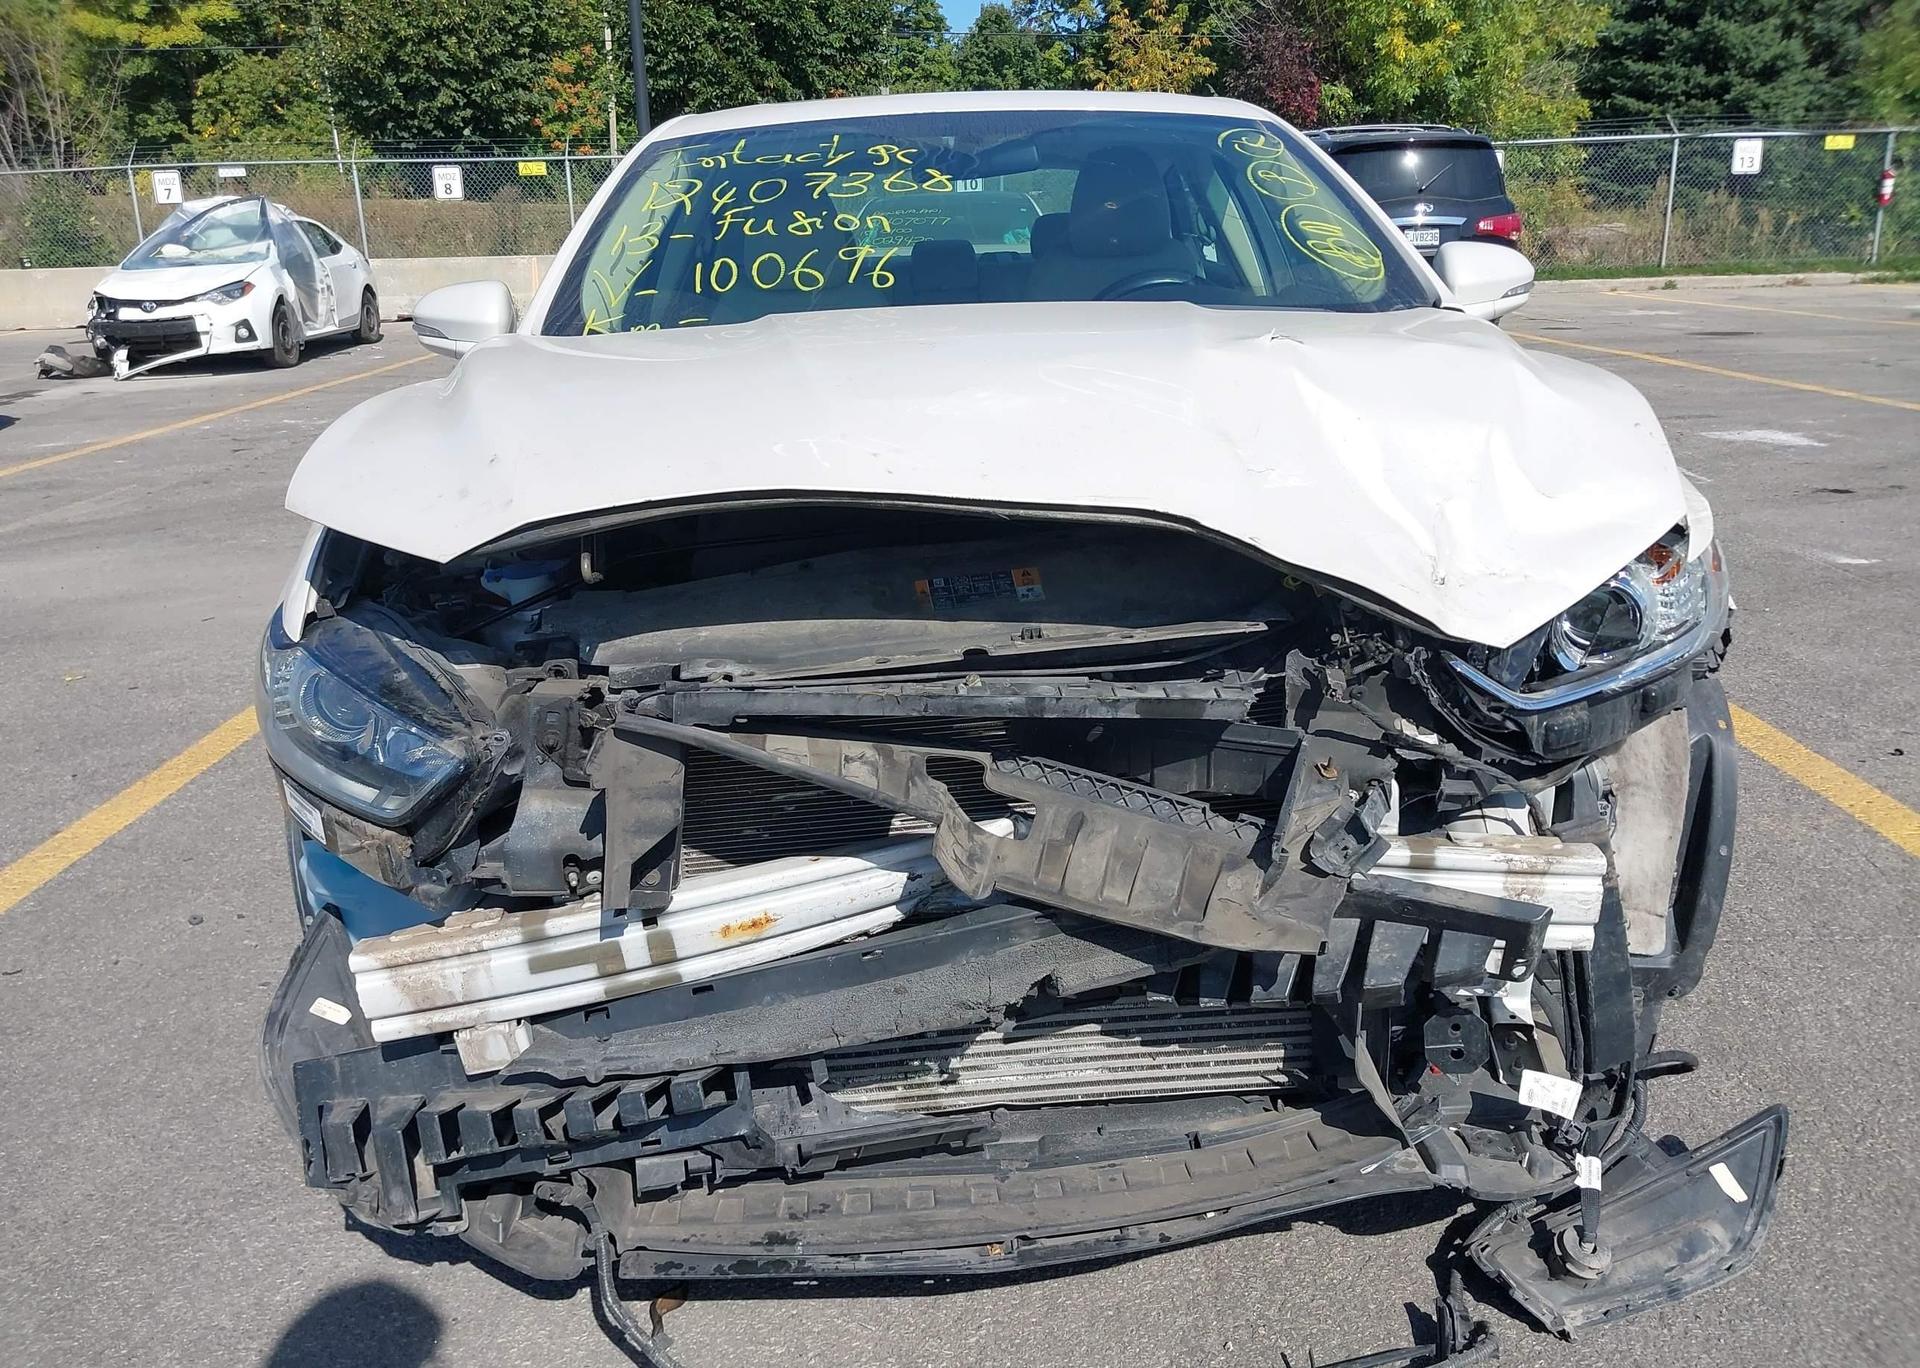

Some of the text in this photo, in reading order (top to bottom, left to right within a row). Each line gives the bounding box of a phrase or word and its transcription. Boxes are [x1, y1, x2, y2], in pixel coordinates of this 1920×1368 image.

[1740, 156, 1754, 168] 13
[158, 177, 177, 186] MDZ
[438, 172, 457, 181] MDZ
[444, 183, 452, 195] 8
[962, 179, 978, 190] 10
[164, 188, 171, 200] 7
[694, 247, 897, 293] 100696
